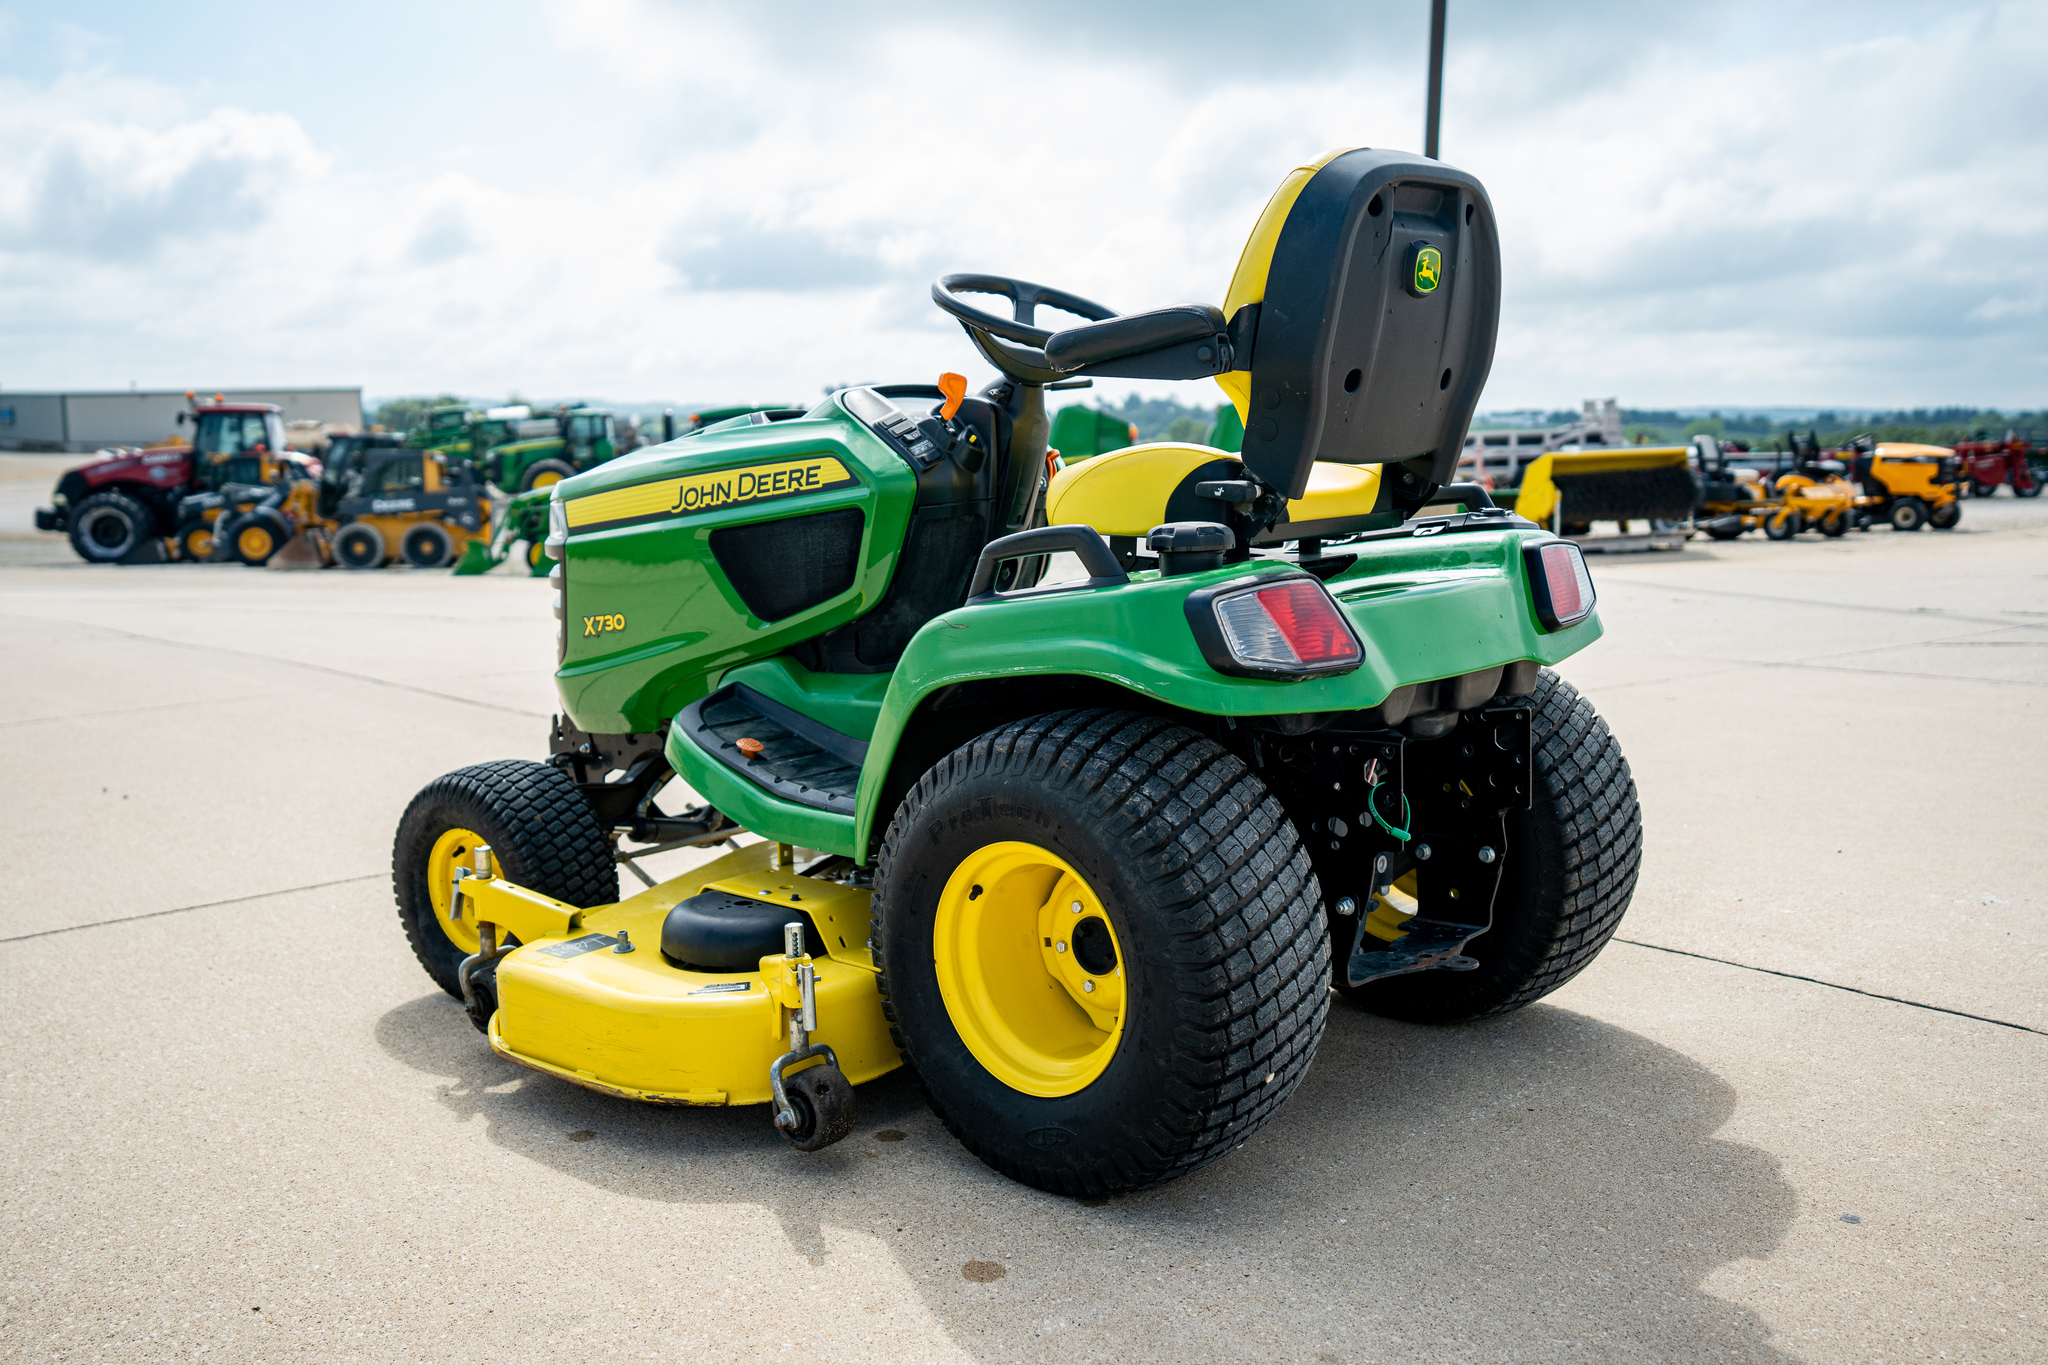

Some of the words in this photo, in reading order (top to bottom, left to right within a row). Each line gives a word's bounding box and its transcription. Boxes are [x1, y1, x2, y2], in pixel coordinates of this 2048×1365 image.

[671, 480, 732, 510] JOHN
[738, 465, 821, 498] DEERE
[583, 613, 626, 637] X730
